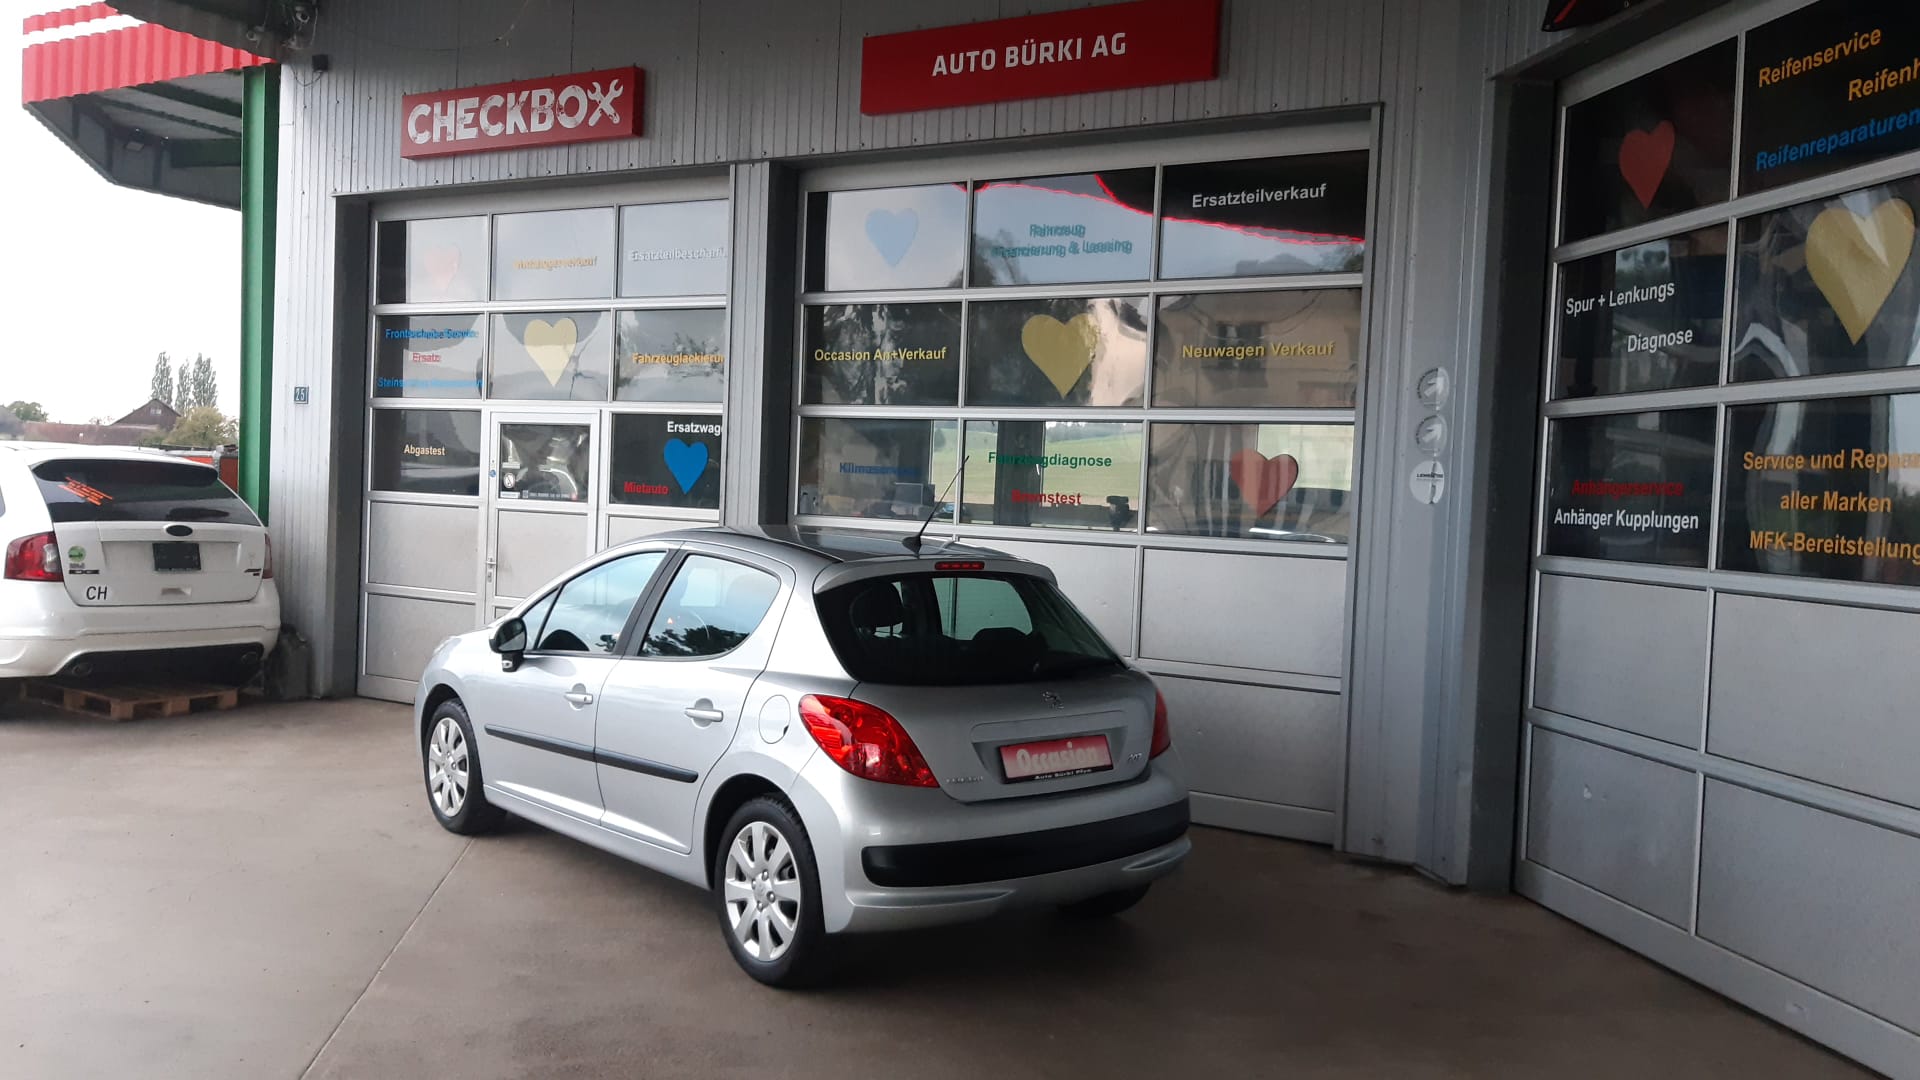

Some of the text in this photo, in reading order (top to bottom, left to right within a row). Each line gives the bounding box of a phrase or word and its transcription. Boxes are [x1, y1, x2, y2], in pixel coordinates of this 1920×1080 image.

[931, 32, 1126, 77] AUTO BÜRKI AG
[1758, 28, 1881, 88] Reifenservice
[1756, 107, 1920, 172] Reifenreparaturen
[1192, 183, 1327, 208] Ersatzteilverkauf
[1566, 282, 1675, 317] Spur + Lenkungs
[1182, 341, 1334, 360] Neuwagen Verkauf
[1627, 329, 1693, 353] Diagnose
[814, 349, 870, 361] Occasion
[667, 421, 723, 436] Ersatzwag
[404, 444, 446, 457] Abgastest
[1743, 451, 1804, 471] Service
[1811, 449, 1845, 469] und
[1780, 490, 1892, 513] aller Marken
[1554, 508, 1699, 533] Anhänger Kupplungen
[1750, 530, 1920, 565] MFK-Bereitstellung
[86, 586, 107, 600] CH
[1016, 741, 1097, 771] Occasion
